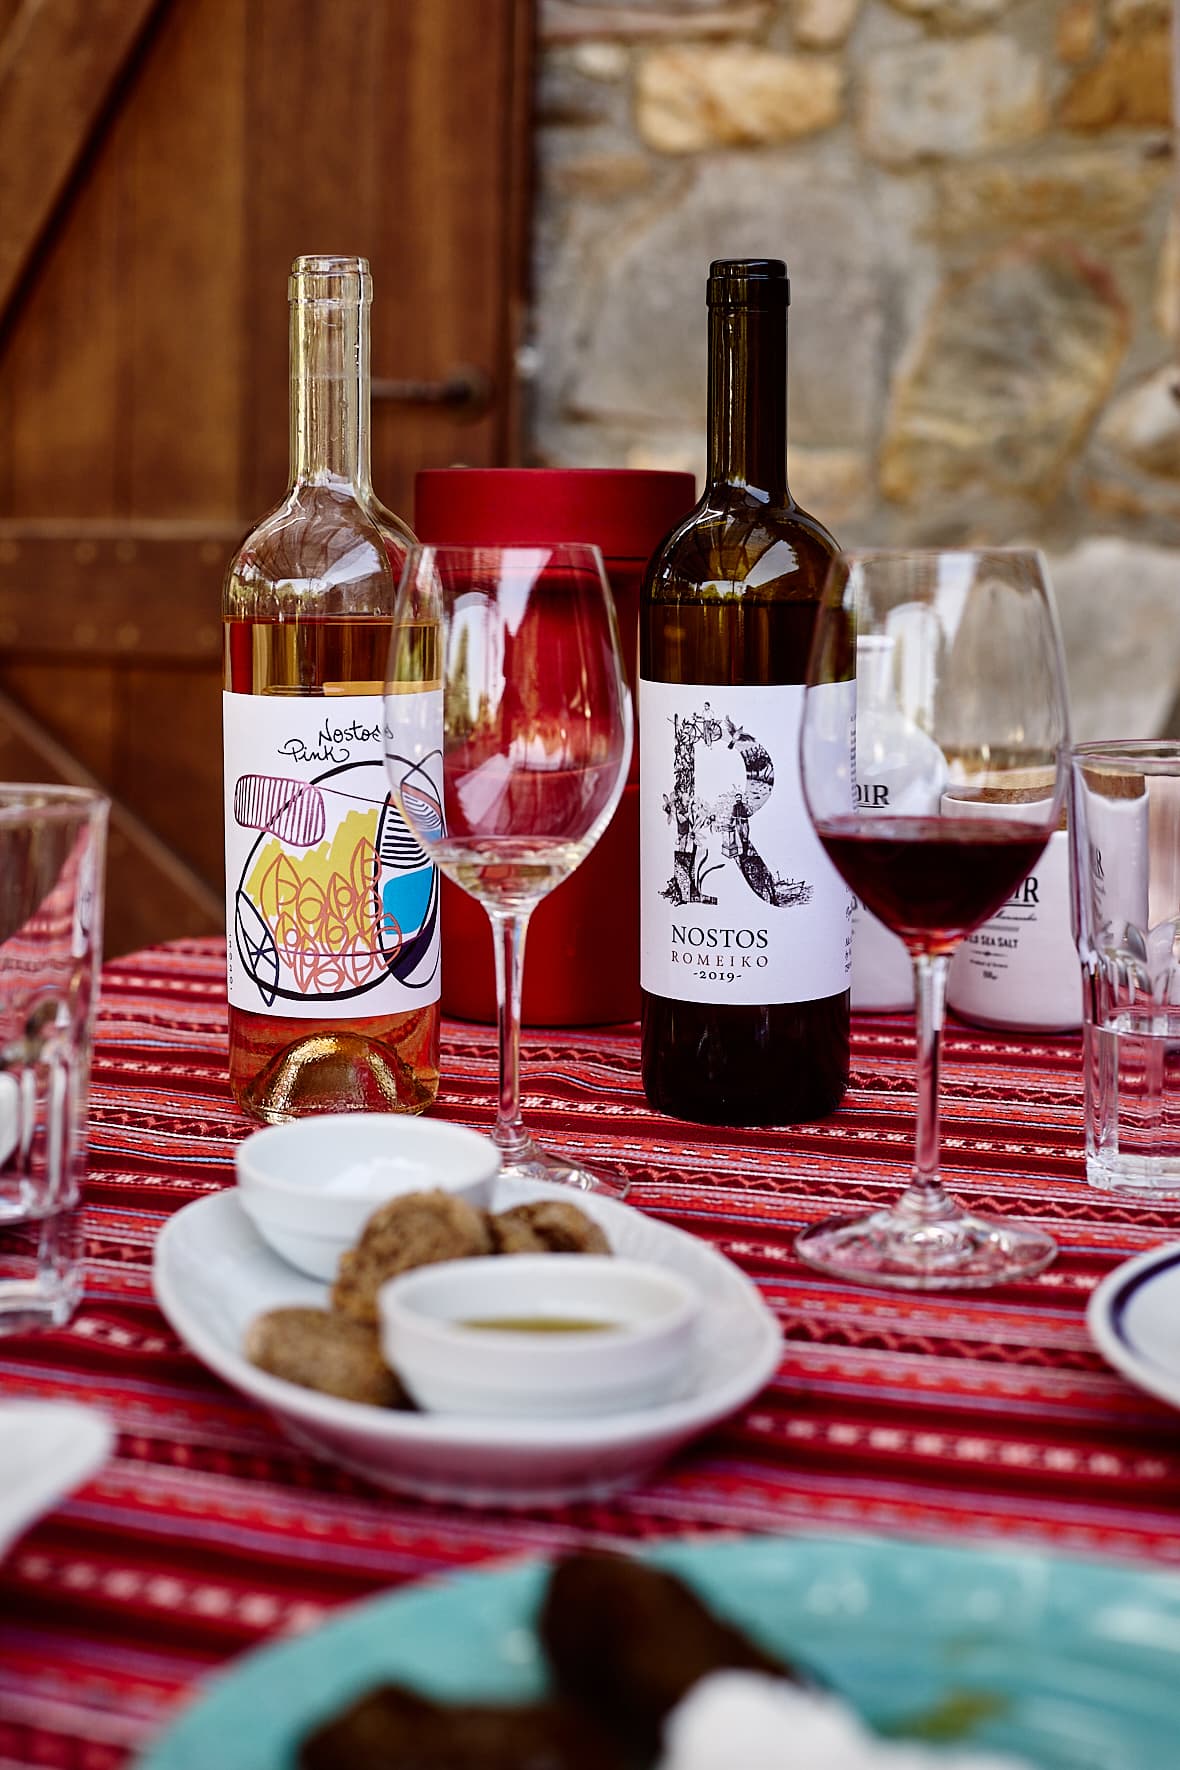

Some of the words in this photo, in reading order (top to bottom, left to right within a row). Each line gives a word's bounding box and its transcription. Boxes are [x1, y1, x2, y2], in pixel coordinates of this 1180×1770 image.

[277, 738, 350, 763] Pink
[671, 924, 768, 948] NOSTOS
[981, 935, 996, 947] SEA
[997, 937, 1018, 948] SALT
[671, 950, 768, 968] ROMEIKO
